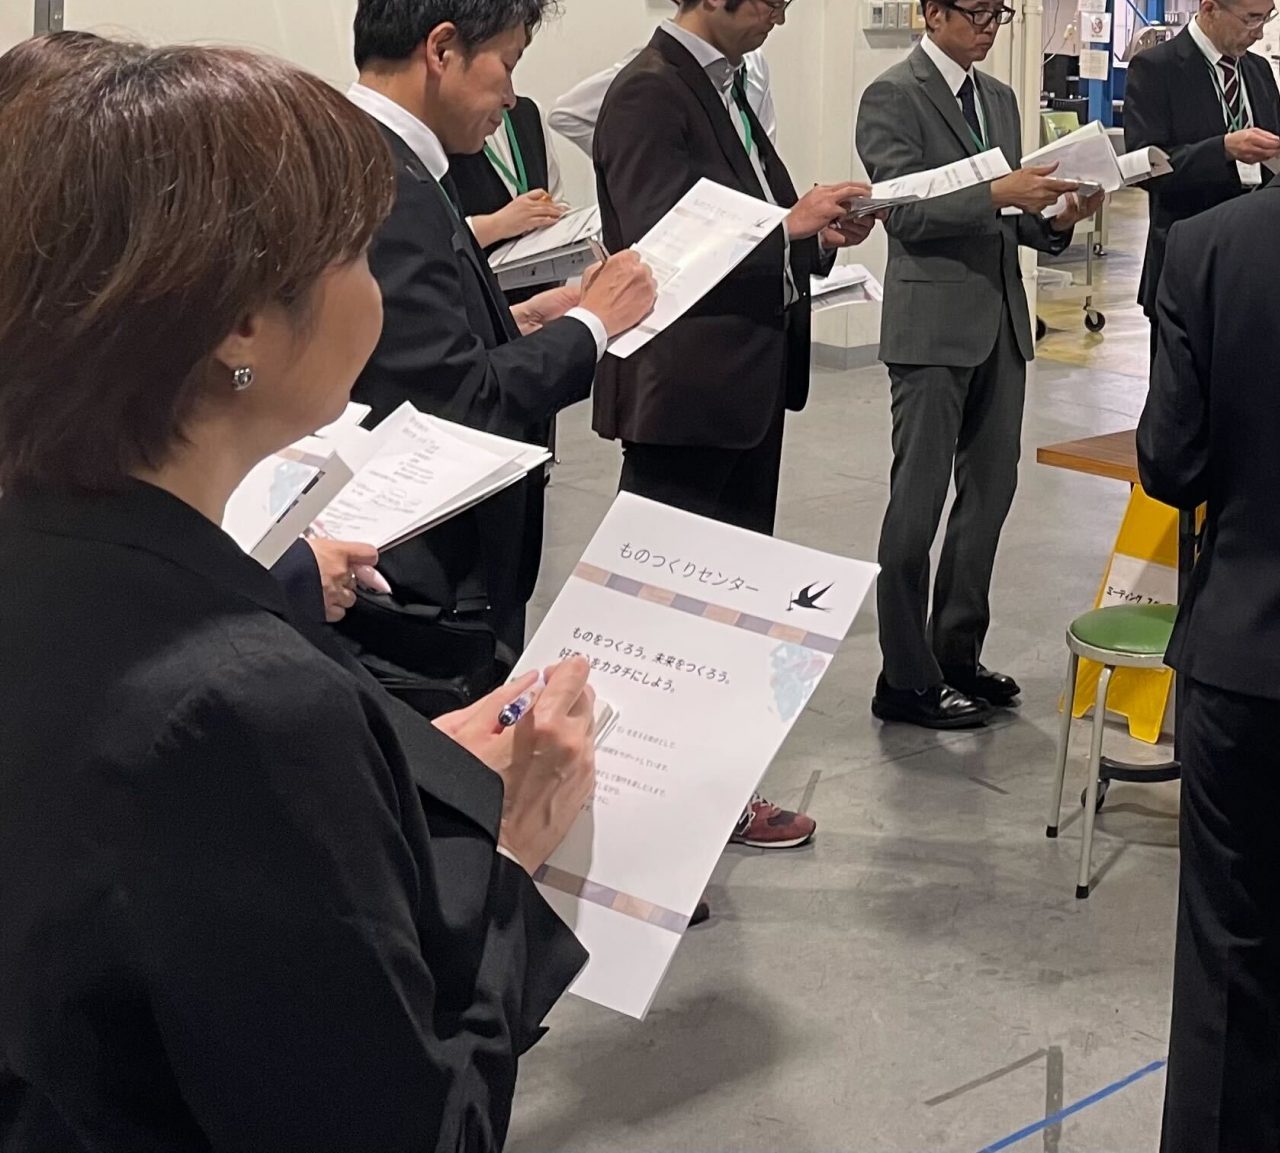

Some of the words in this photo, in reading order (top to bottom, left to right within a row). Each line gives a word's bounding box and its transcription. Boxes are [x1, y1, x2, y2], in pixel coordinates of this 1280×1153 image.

[620, 542, 760, 592] ものつくりセンター
[558, 647, 676, 694] 好をカタチにしよう。
